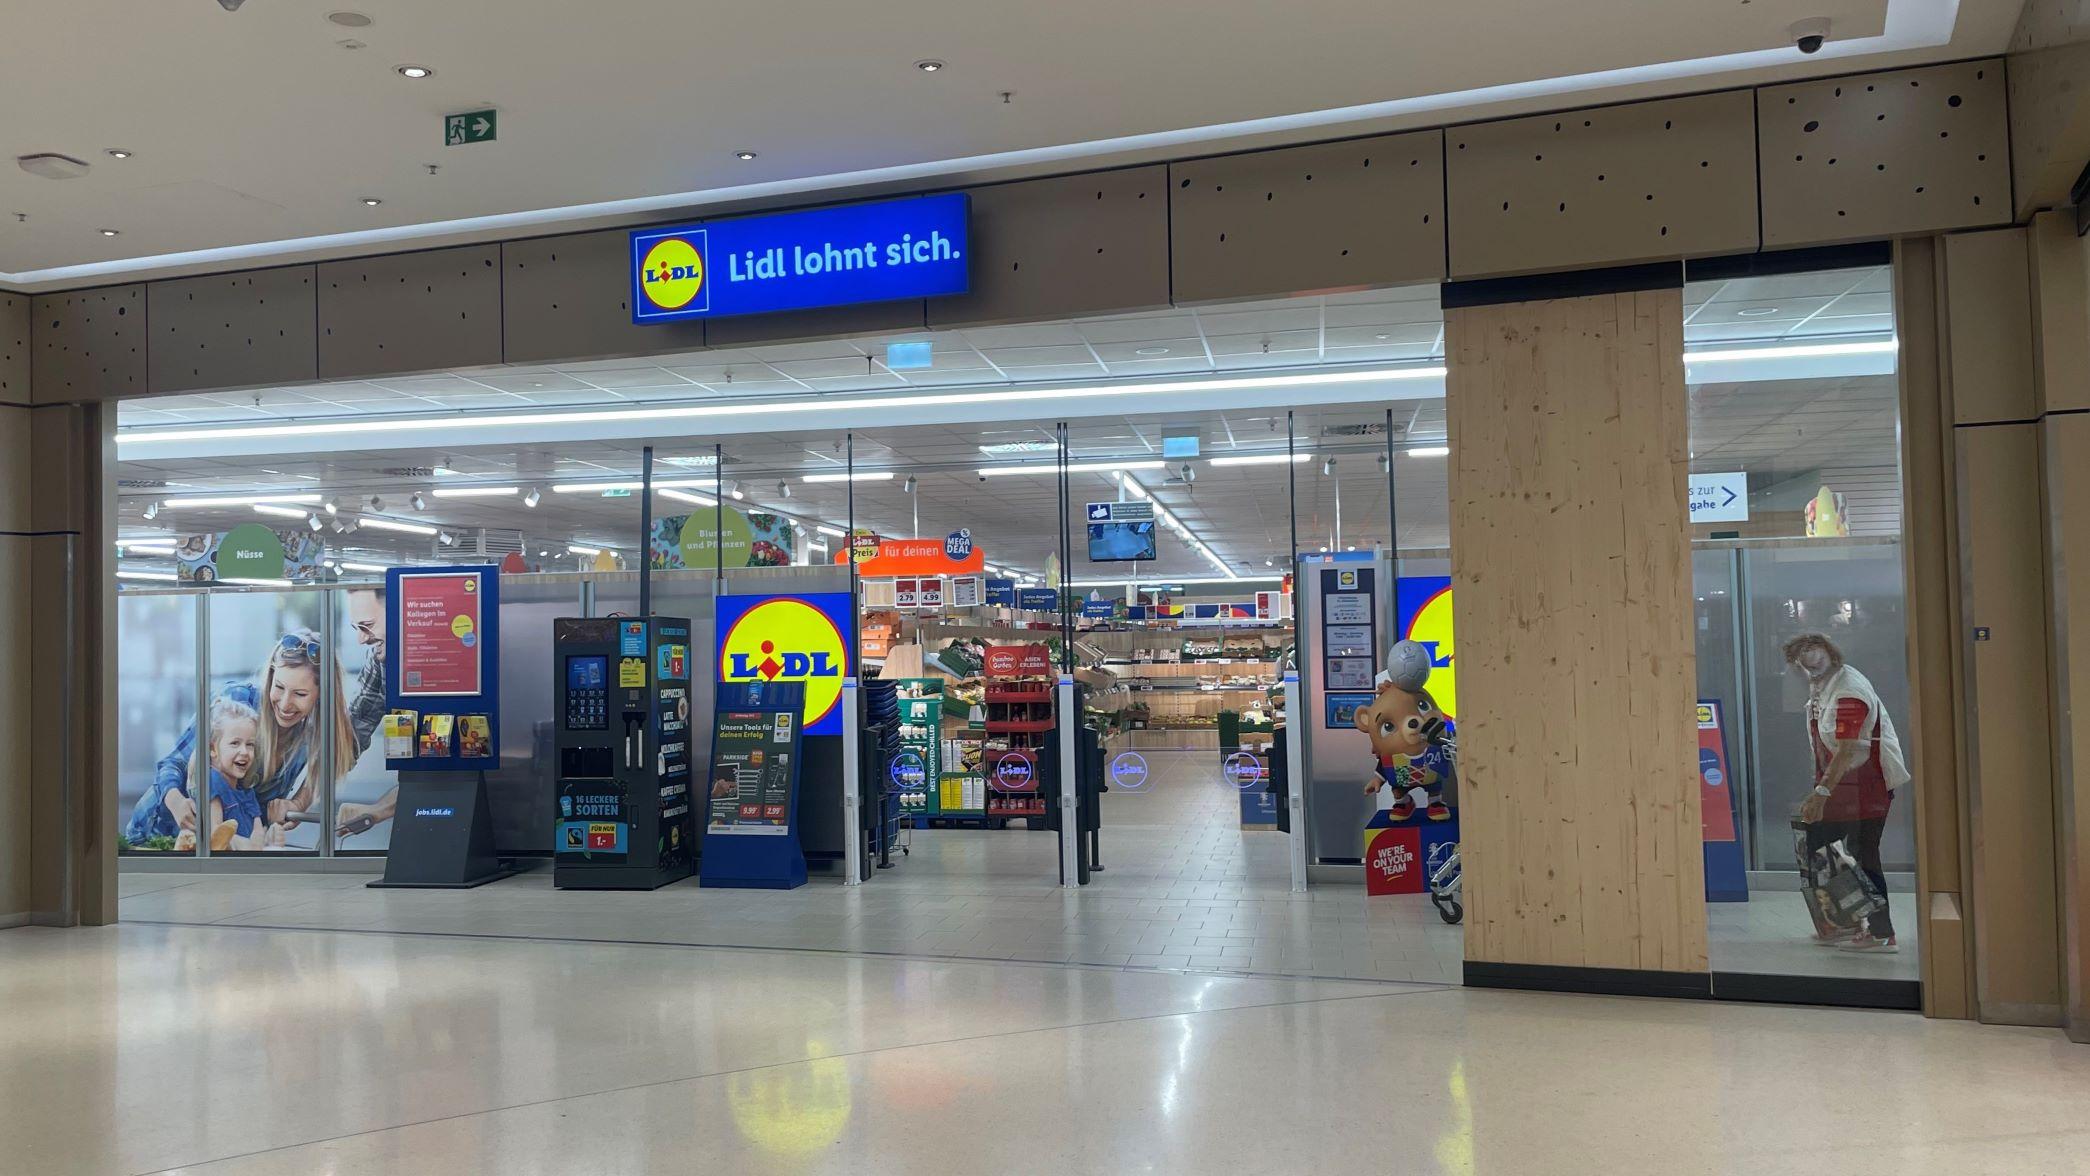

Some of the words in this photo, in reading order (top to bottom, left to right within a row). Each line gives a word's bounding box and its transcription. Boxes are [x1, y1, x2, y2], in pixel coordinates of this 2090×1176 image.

[729, 248, 787, 282] Lidl
[795, 242, 878, 275] lohnt
[886, 231, 961, 265] sich.
[1698, 486, 1715, 496] zur
[687, 541, 704, 550] und
[947, 537, 971, 546] MEGA
[885, 545, 900, 557] für
[902, 545, 939, 557] deinen
[946, 545, 970, 554] DEAL
[236, 549, 264, 560] Nüsse
[899, 594, 914, 602] 2.79
[923, 594, 939, 602] 4.99
[419, 600, 444, 608] suchen
[406, 610, 436, 619] Kollegen
[406, 619, 433, 627] Verkauf
[762, 723, 773, 731] für
[743, 731, 764, 739] Erfolg
[1426, 751, 1441, 765] 24
[576, 795, 584, 803] 16
[586, 795, 619, 803] LECKERE
[415, 808, 452, 816] jobs.lidl.de
[576, 804, 619, 815] SORTEN
[591, 824, 603, 832] FÜR
[1378, 844, 1405, 858] WE'RE
[1373, 857, 1388, 869] ON
[1388, 852, 1413, 867] YOUR
[1382, 862, 1407, 876] TEAM
